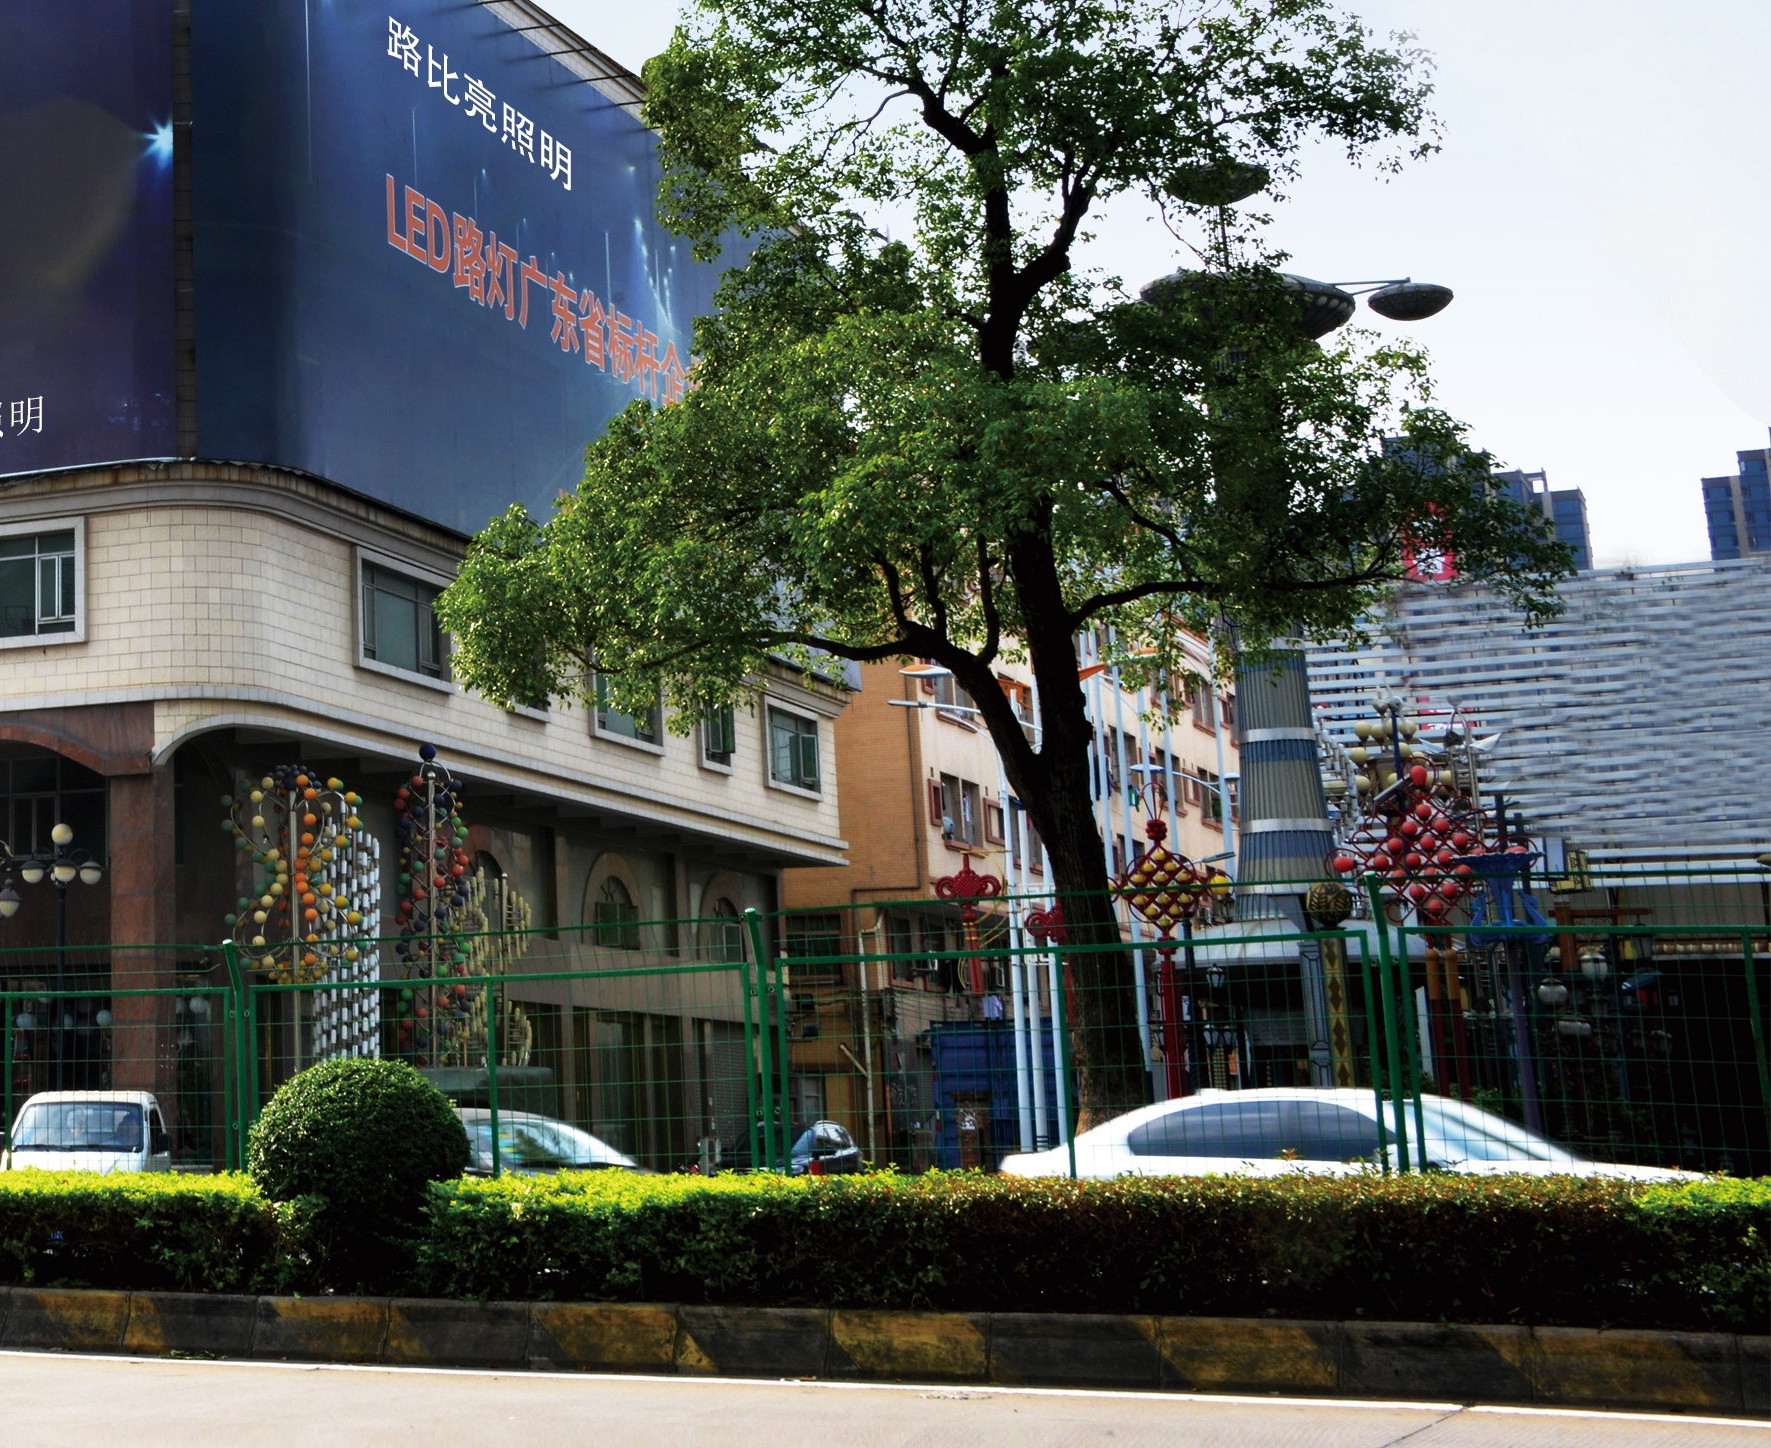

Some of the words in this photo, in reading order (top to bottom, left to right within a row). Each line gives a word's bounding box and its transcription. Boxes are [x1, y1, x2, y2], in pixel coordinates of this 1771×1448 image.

[387, 16, 572, 191] 路比亮照明
